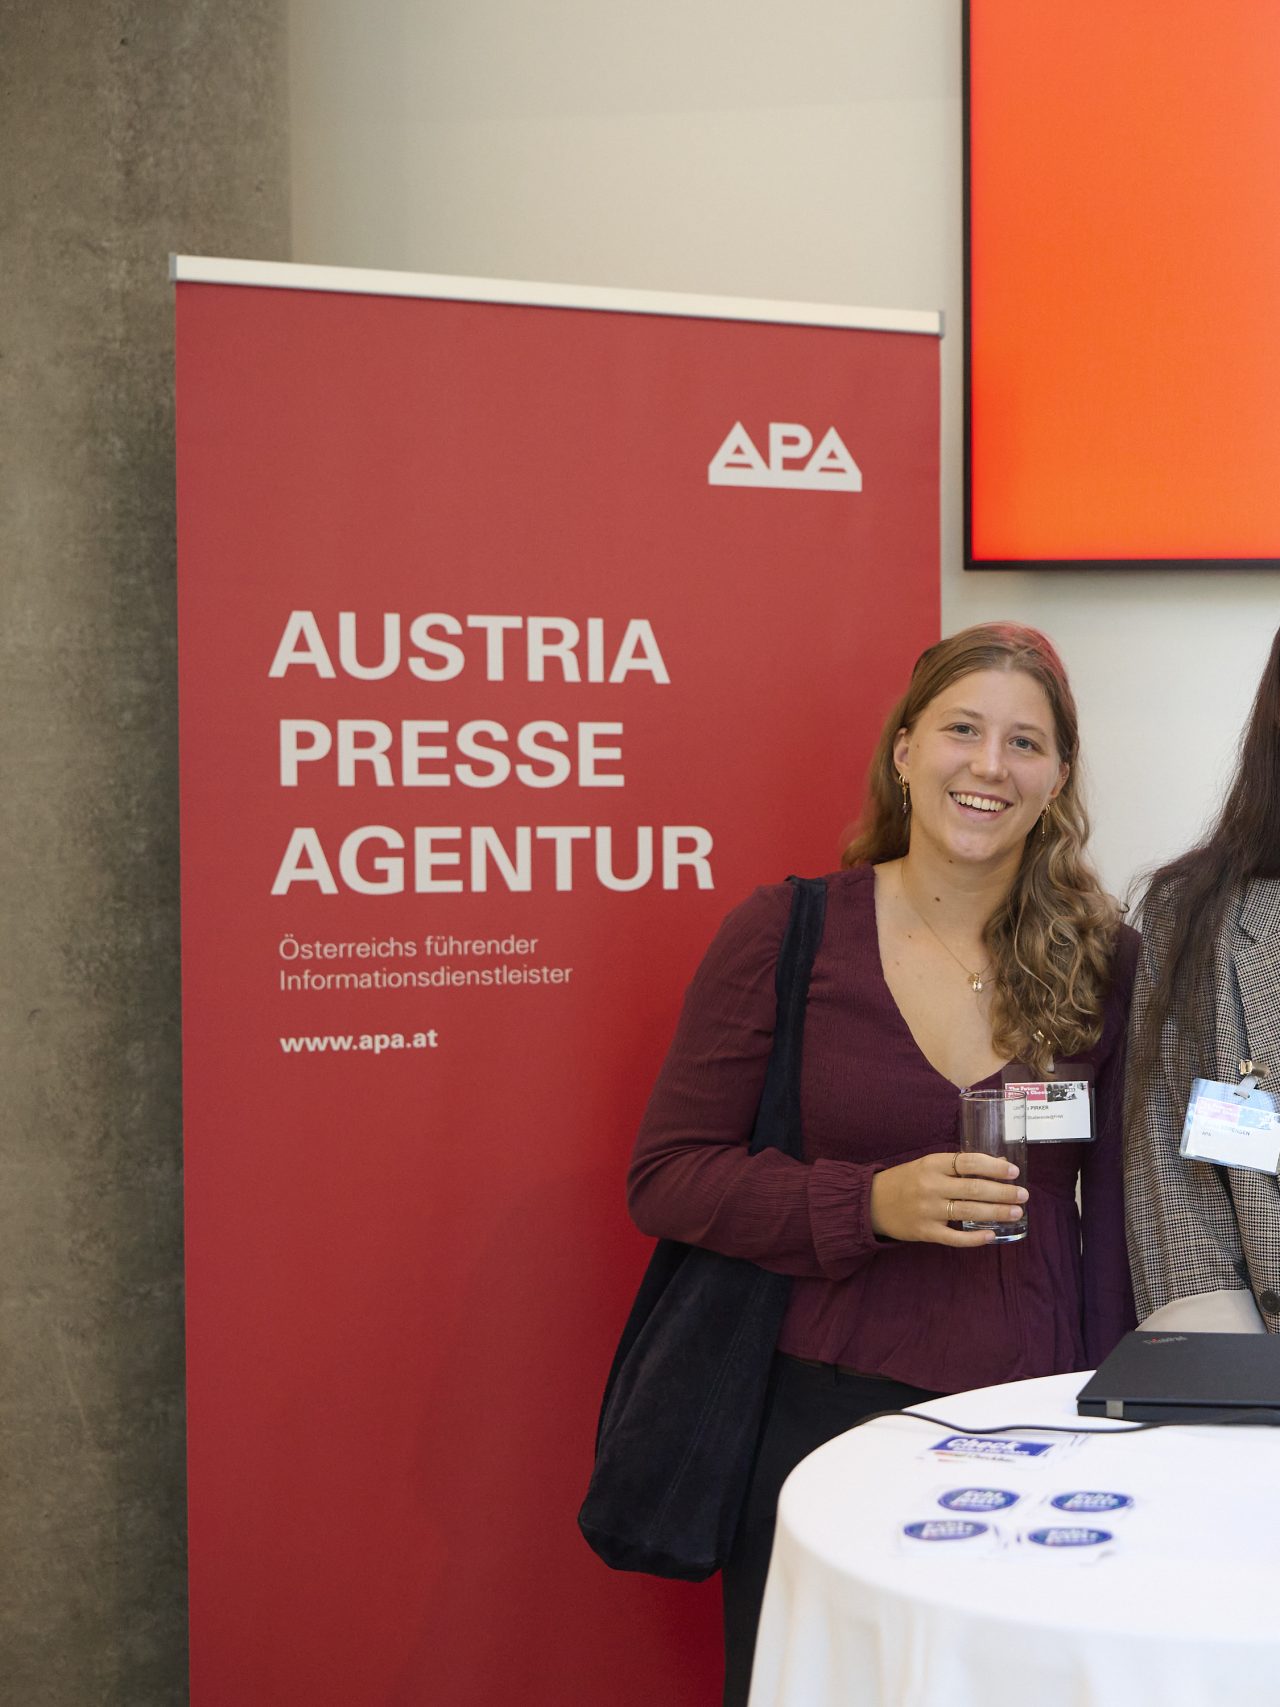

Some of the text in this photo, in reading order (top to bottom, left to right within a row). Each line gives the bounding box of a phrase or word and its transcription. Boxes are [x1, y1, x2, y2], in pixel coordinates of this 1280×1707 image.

[708, 420, 862, 493] APA
[269, 610, 671, 684] AUSTRIA
[280, 720, 625, 788] PRESSE
[271, 826, 715, 896] AGENTUR
[279, 933, 539, 960] Österreichs führender
[280, 964, 573, 991] Informationsdienstleister
[280, 1029, 438, 1054] www.apa.at
